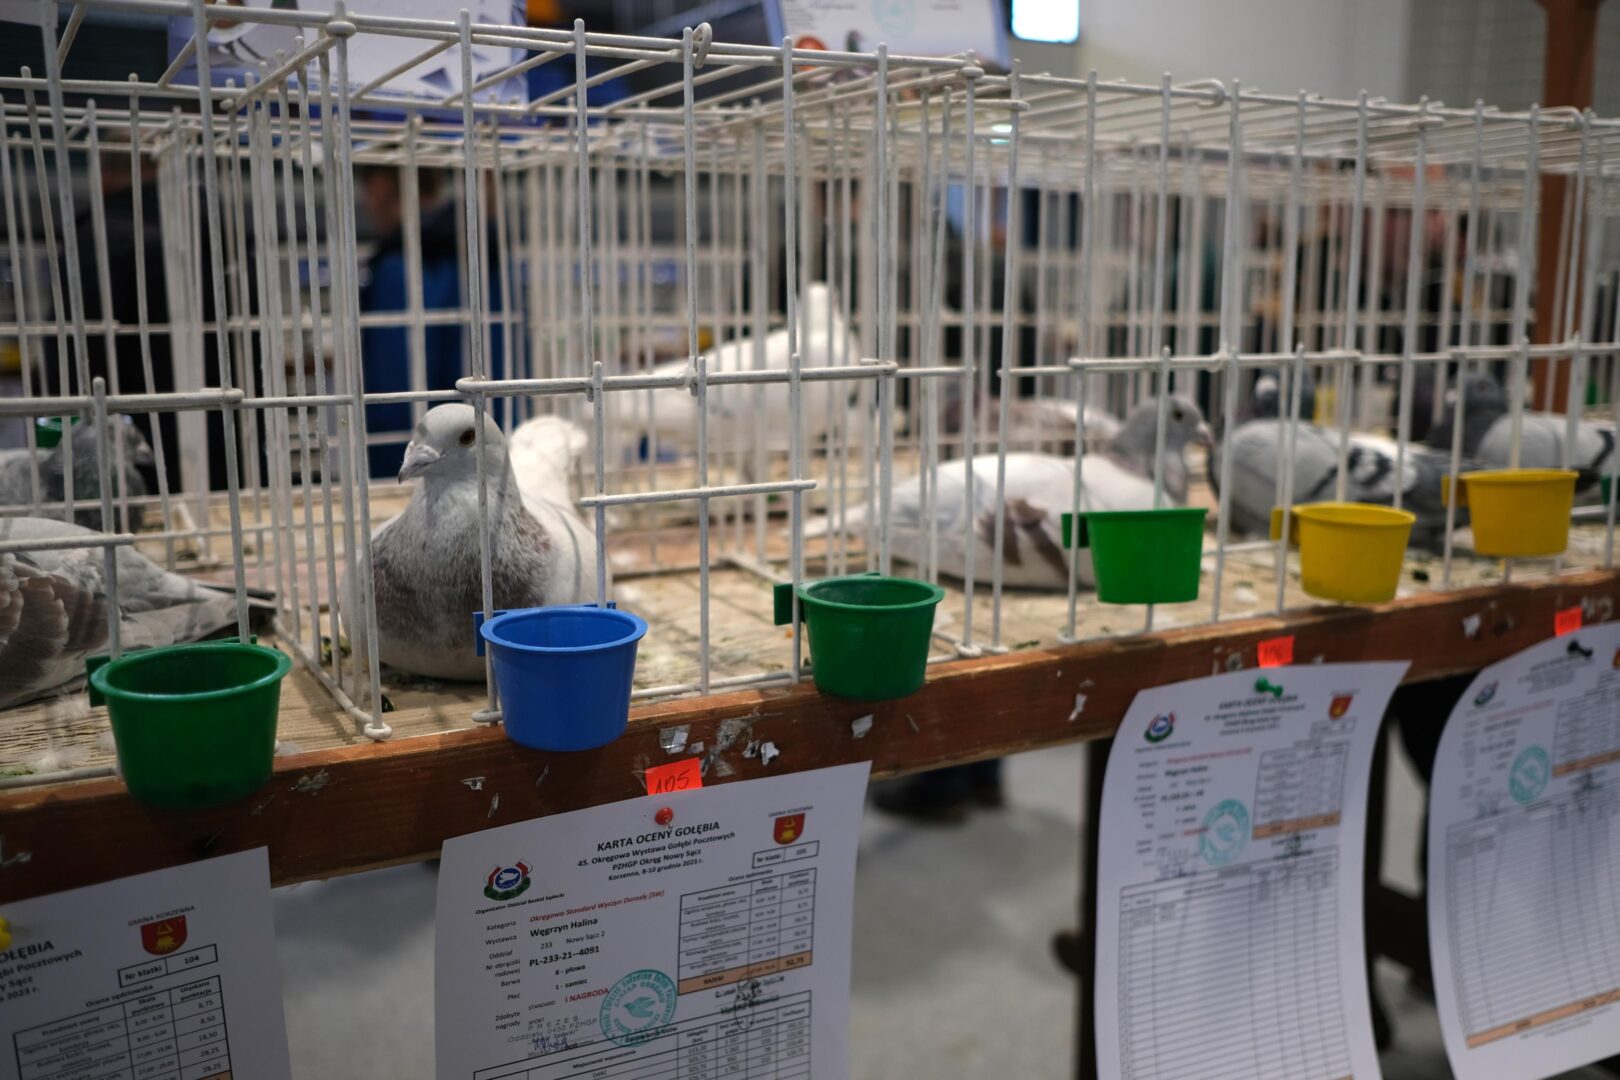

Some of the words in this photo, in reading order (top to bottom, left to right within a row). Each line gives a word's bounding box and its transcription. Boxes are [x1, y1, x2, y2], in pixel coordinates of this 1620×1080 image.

[655, 769, 690, 793] 105
[597, 837, 634, 851] KARTA
[636, 829, 674, 844] OCENY
[675, 821, 721, 837] GOŁĘBIA
[592, 850, 631, 865] Okręgowa
[632, 844, 667, 859] Wystawa
[668, 840, 692, 852] Gołębi
[693, 831, 736, 848] Pocztowych
[612, 859, 639, 871] PZHGP
[639, 855, 662, 866] Okręg
[663, 852, 685, 863] Nowy
[686, 848, 702, 859] Sącz
[608, 869, 641, 881] Korzenna,
[642, 866, 657, 875] 8-10
[657, 861, 682, 874] grudnia
[682, 858, 699, 867] 2023
[128, 915, 154, 927] GMINA
[156, 905, 195, 919] KORZENNA
[486, 919, 517, 932] Kategoria
[529, 911, 566, 924] Okręgowa
[566, 903, 597, 917] Standard
[597, 900, 623, 914] Wyczyn
[623, 893, 649, 907] Dorosły
[485, 934, 518, 947] Wystawca
[530, 922, 569, 940] Węgrzyn
[570, 917, 598, 930] Halina
[489, 949, 513, 961] Oddział
[540, 941, 553, 951] 233
[566, 934, 585, 945] Nowy
[586, 931, 601, 943] Sącz
[601, 930, 607, 939] 2
[17, 949, 83, 974] Pocztowych
[184, 955, 200, 965] 104
[485, 963, 495, 972] Nr
[495, 959, 521, 971] obrączki
[125, 973, 136, 981] Nr
[138, 965, 163, 978] klatki
[495, 968, 521, 979] rodowej
[565, 964, 586, 976] płowa
[8, 976, 34, 989] Sącz
[501, 978, 521, 988] Barwa
[565, 977, 588, 989] samiec
[7, 987, 31, 1001] 2023
[508, 992, 521, 1001] Płeć
[528, 1000, 556, 1011] STANDARD
[569, 986, 610, 1003] NAGRODA
[86, 997, 110, 1008] Ocena
[200, 1015, 216, 1025] 8,50
[495, 1010, 521, 1023] Zdobyte
[495, 1020, 521, 1032] nagrody
